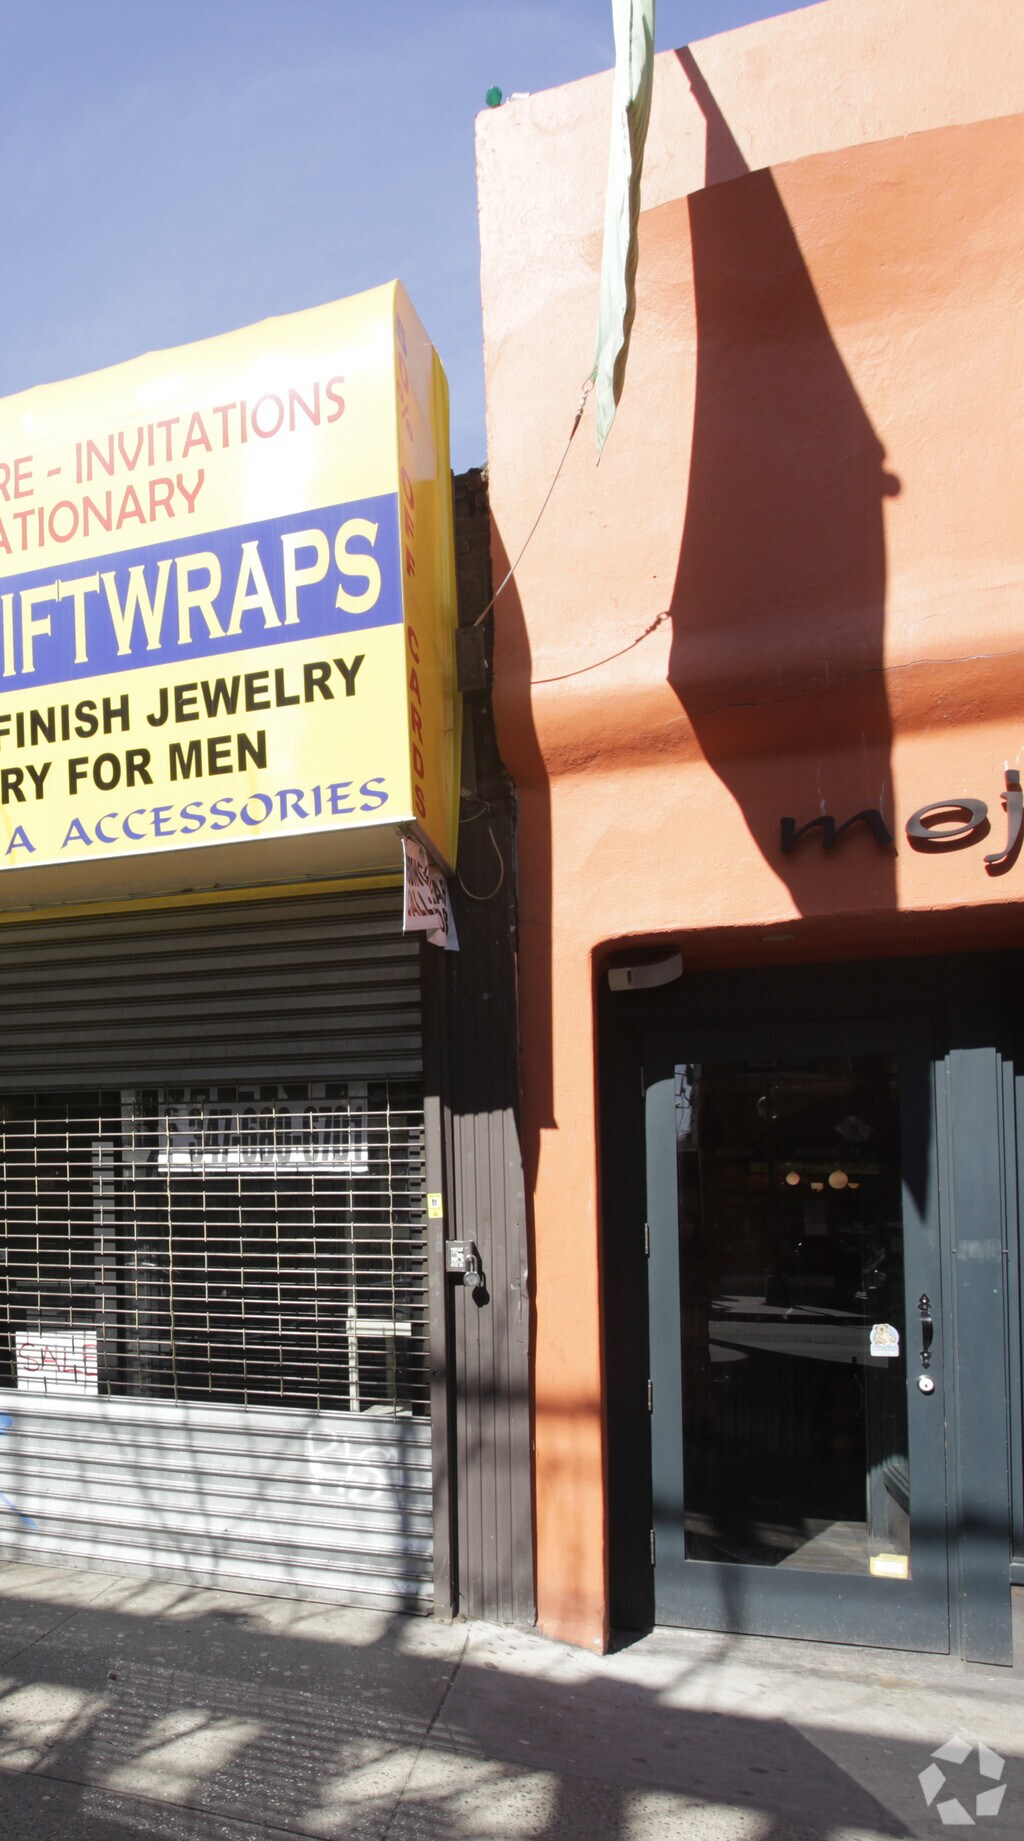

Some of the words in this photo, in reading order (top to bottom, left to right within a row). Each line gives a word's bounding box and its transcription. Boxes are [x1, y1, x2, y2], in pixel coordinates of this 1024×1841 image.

[75, 376, 346, 485] INVITATIONS
[147, 654, 366, 726] JEWELRY
[407, 625, 426, 819] CARDS
[68, 746, 153, 795] FOR
[169, 729, 268, 781] MEN
[6, 825, 36, 857] A
[60, 777, 389, 850] ACCESSORIES
[18, 1343, 97, 1376] SALE
